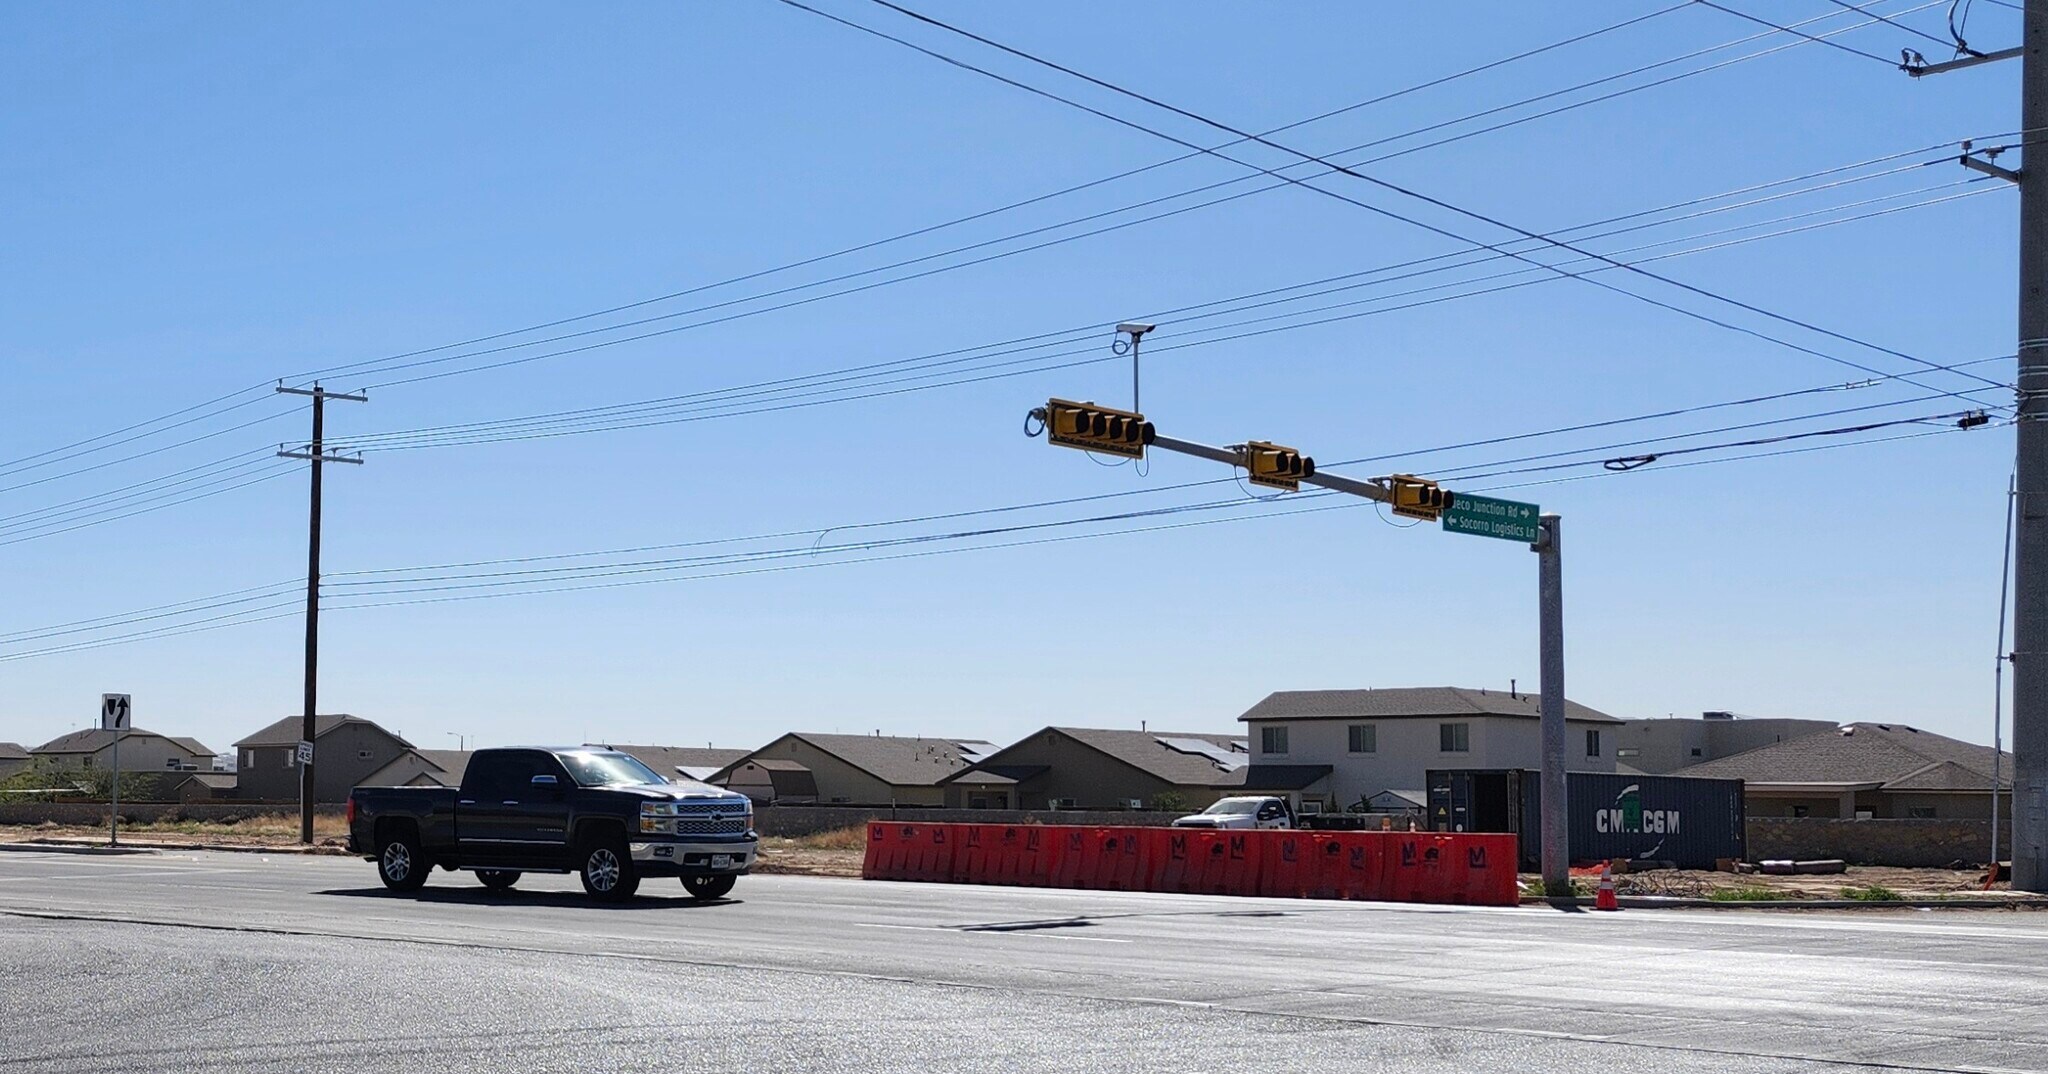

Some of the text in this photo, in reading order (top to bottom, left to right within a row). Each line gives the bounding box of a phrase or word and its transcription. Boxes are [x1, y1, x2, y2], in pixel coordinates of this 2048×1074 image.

[1451, 499, 1518, 518] eco Junction Rd
[1460, 516, 1535, 538] Socorro Logistics Ln
[299, 751, 311, 762] 45
[1596, 809, 1680, 834] CM CGM
